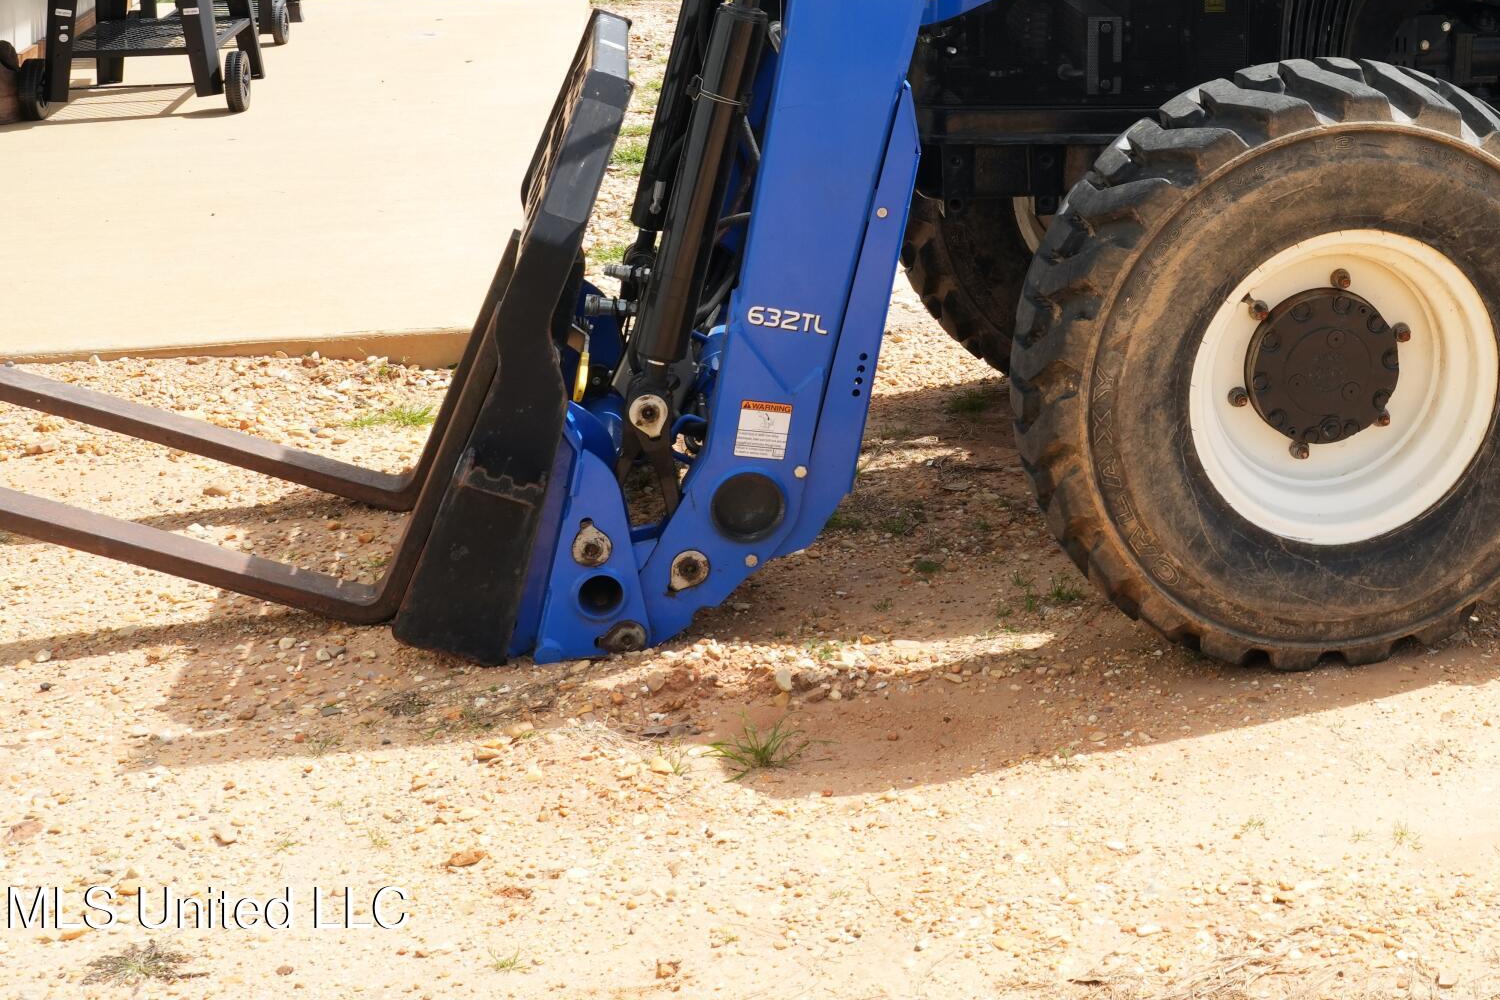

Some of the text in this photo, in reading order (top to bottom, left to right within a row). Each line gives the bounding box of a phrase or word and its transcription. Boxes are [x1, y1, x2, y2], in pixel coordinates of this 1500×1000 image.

[747, 306, 829, 335] 632TL
[752, 403, 791, 413] WARNING
[1092, 365, 1181, 586] GALAXY
